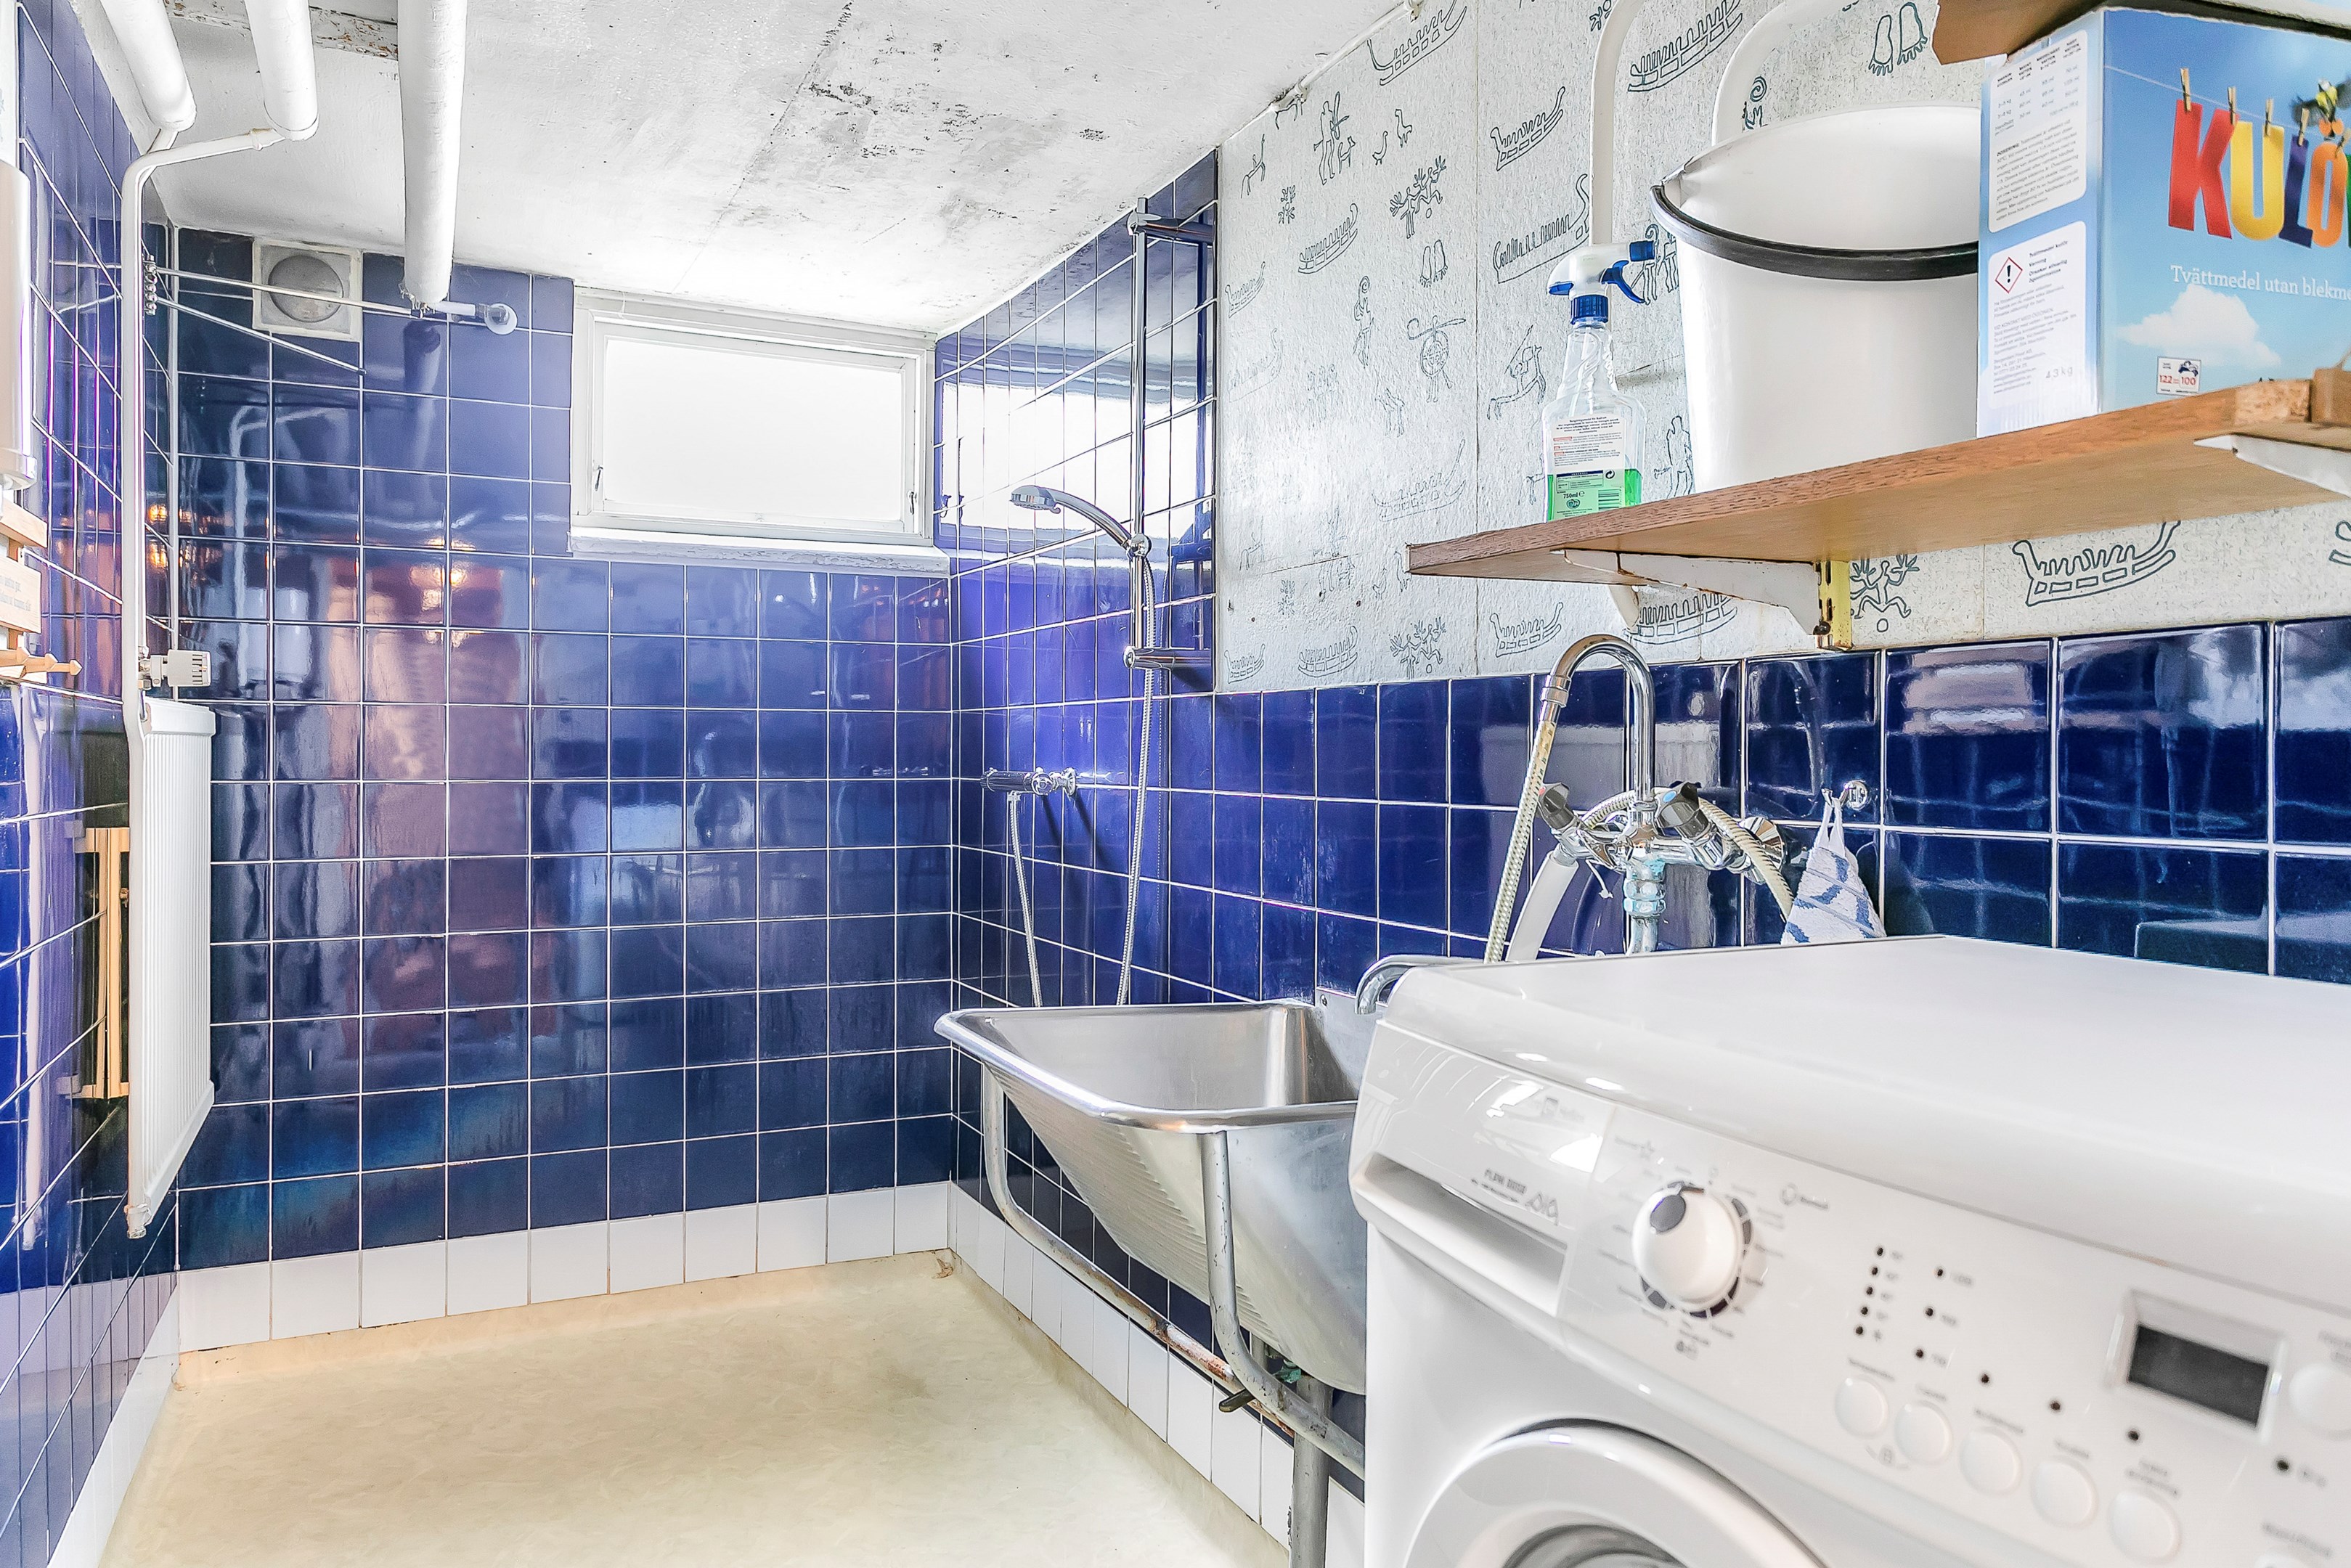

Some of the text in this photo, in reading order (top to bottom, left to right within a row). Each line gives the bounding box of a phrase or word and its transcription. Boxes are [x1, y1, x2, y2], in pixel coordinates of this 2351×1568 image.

[2169, 99, 2351, 248] KULÖ
[2170, 264, 2261, 291] Tvättmedel
[2265, 278, 2299, 295] utan
[2159, 375, 2172, 383] 122
